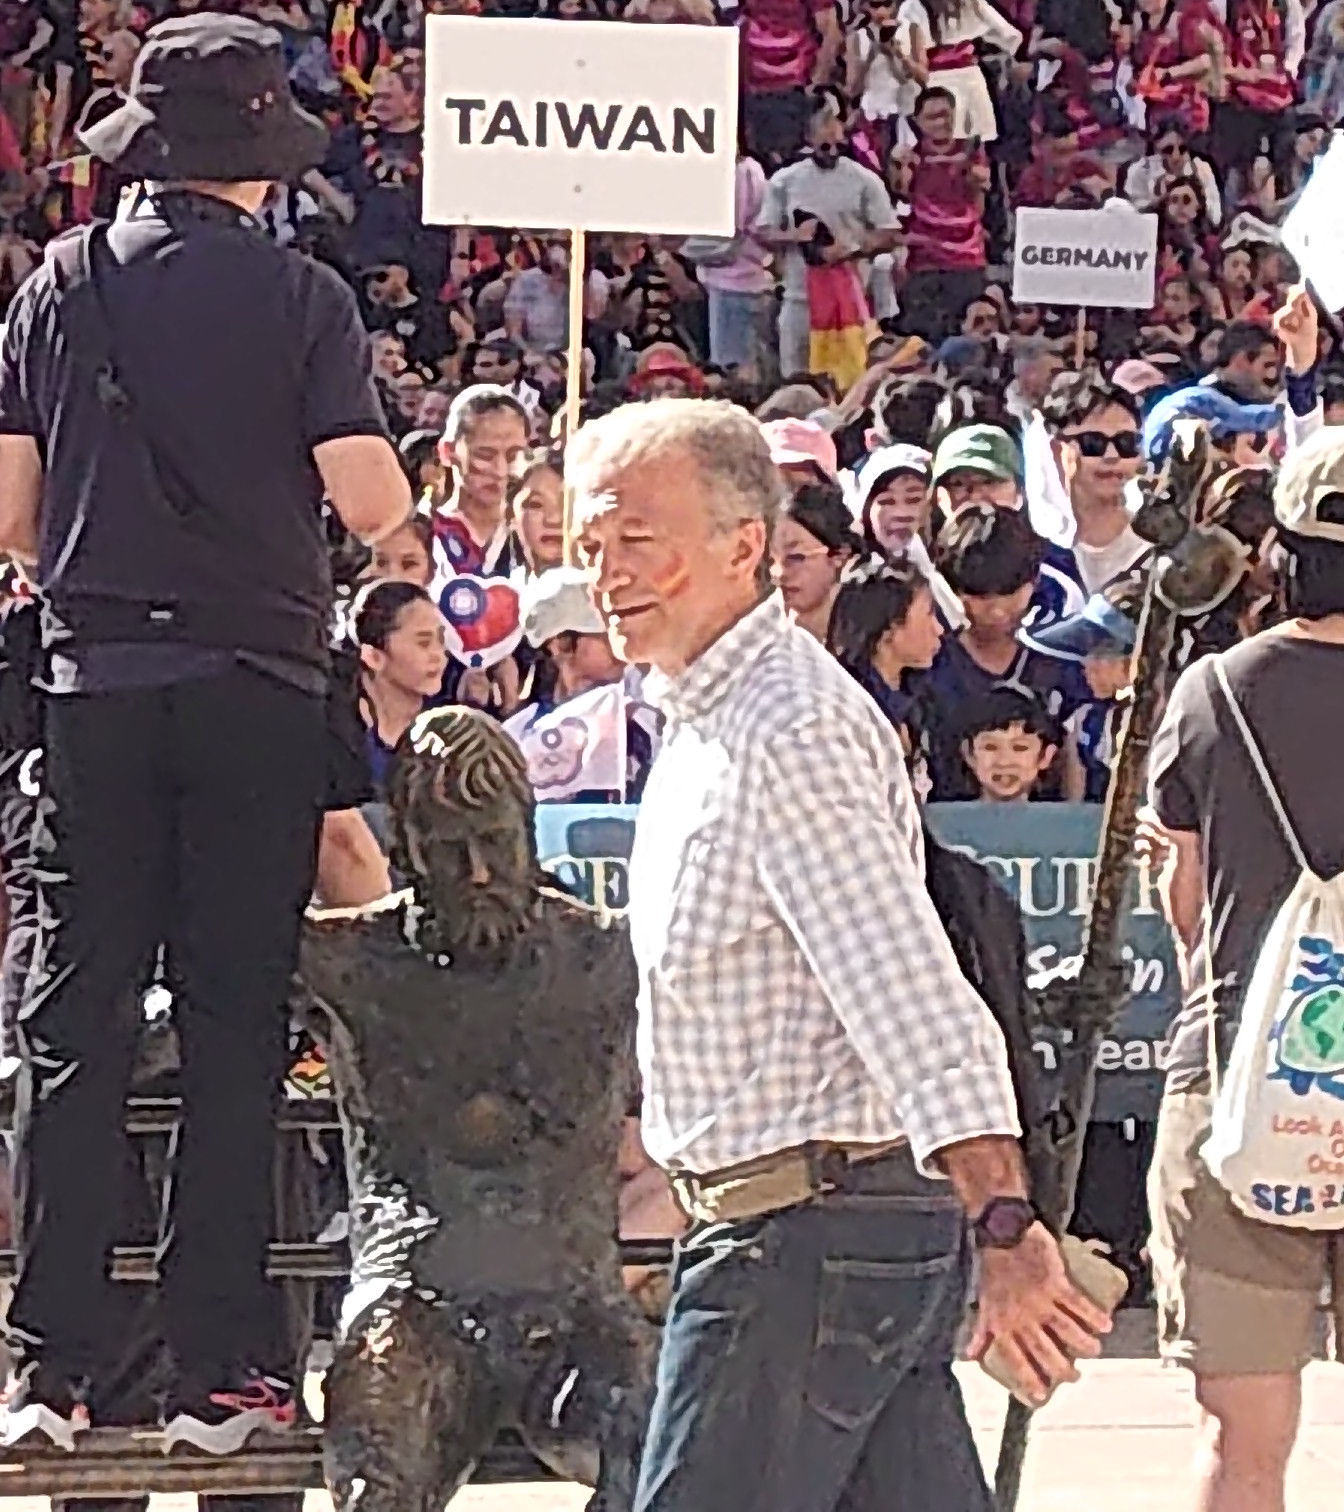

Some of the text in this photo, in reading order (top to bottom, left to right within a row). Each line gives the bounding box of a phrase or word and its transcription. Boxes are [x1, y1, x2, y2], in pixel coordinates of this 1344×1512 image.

[445, 97, 716, 154] TAIWAN
[1021, 244, 1149, 271] GERMANY
[1272, 1113, 1322, 1135] Look
[1251, 1182, 1315, 1216] SEA
